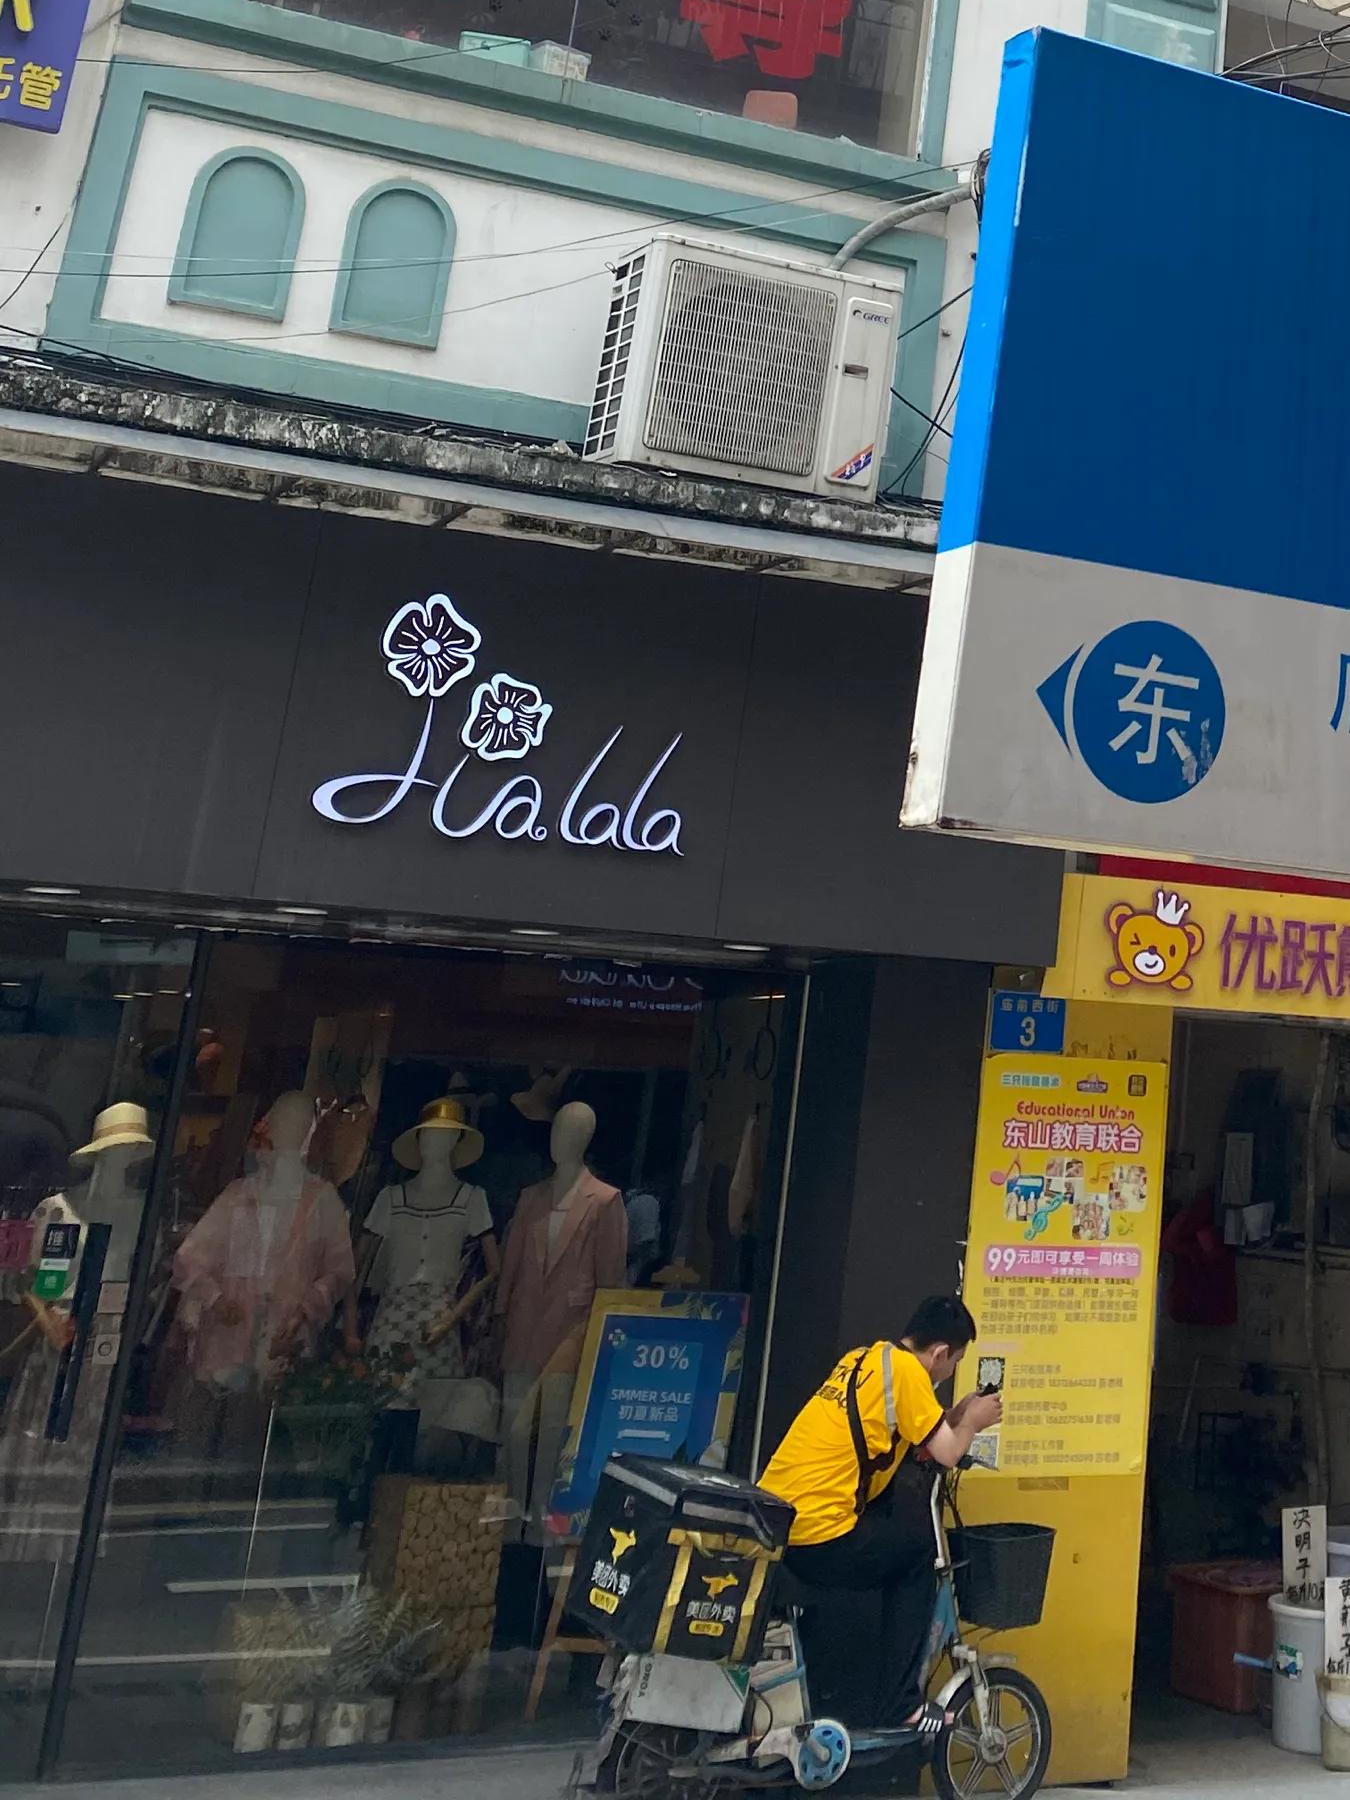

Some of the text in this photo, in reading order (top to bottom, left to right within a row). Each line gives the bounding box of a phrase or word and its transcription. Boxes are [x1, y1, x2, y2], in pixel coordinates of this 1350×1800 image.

[1106, 654, 1199, 766] 东
[1020, 1016, 1037, 1047] 3
[1002, 1117, 1143, 1154] 东山教育联合
[632, 1344, 690, 1371] 30%
[660, 1391, 692, 1404] SALE
[618, 1405, 679, 1423] 初夏新品
[1292, 1508, 1311, 1579] 决明子
